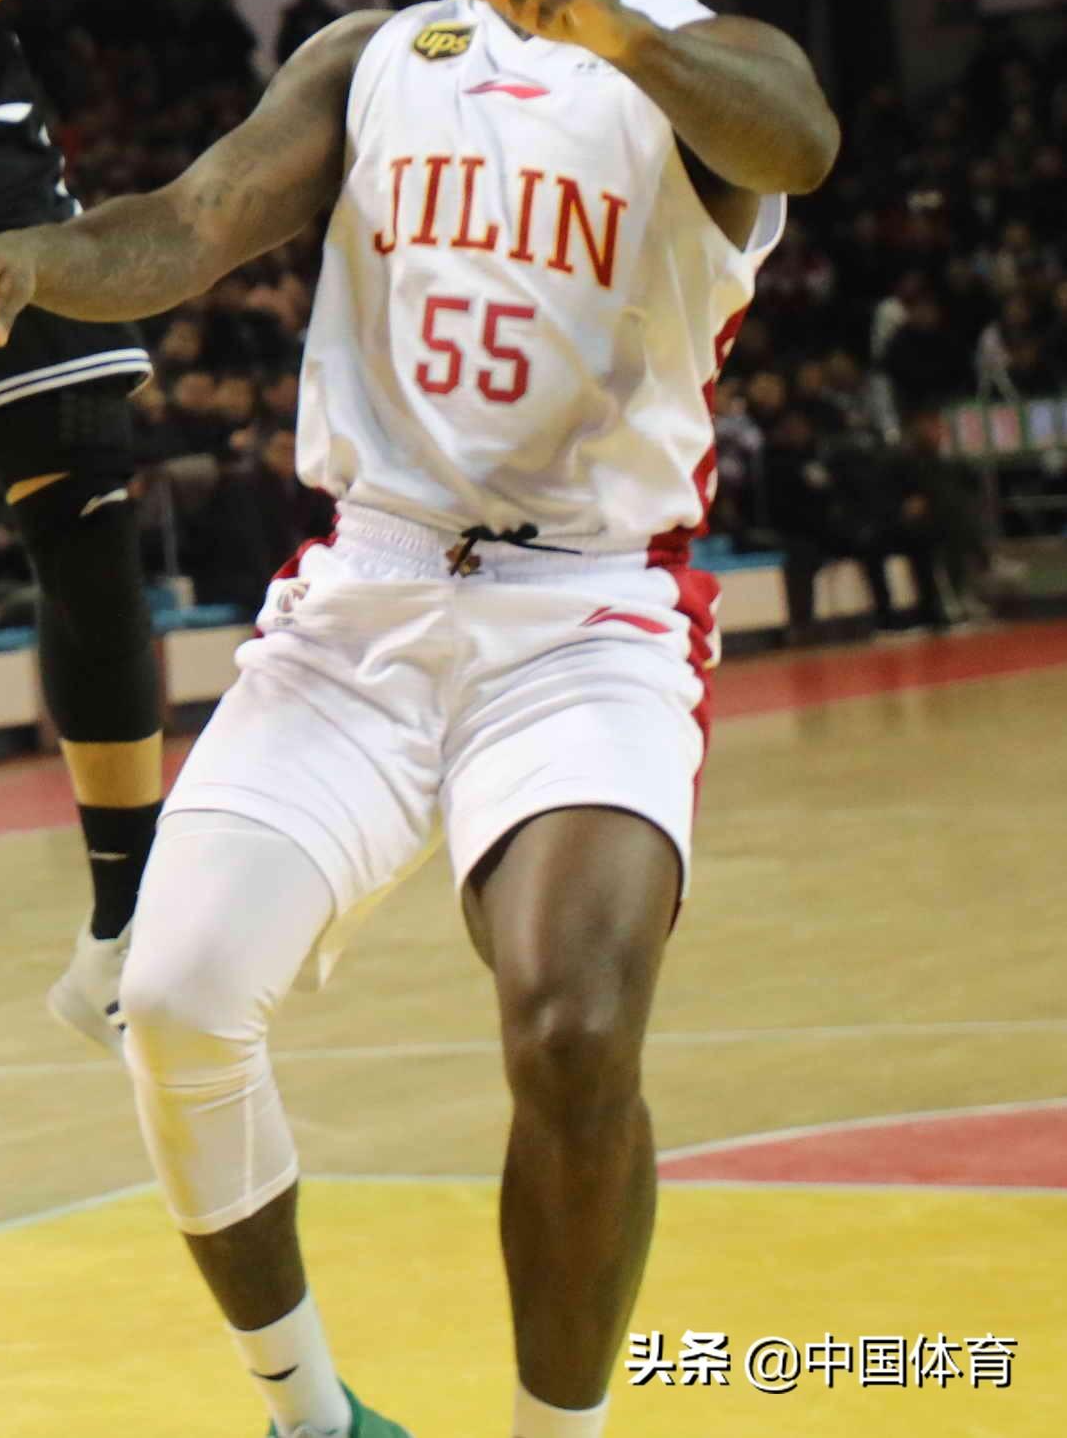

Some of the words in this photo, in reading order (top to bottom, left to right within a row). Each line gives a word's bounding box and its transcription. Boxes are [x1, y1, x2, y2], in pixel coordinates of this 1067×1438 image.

[416, 31, 470, 59] ups
[373, 156, 629, 290] JILIN
[414, 295, 537, 405] 55
